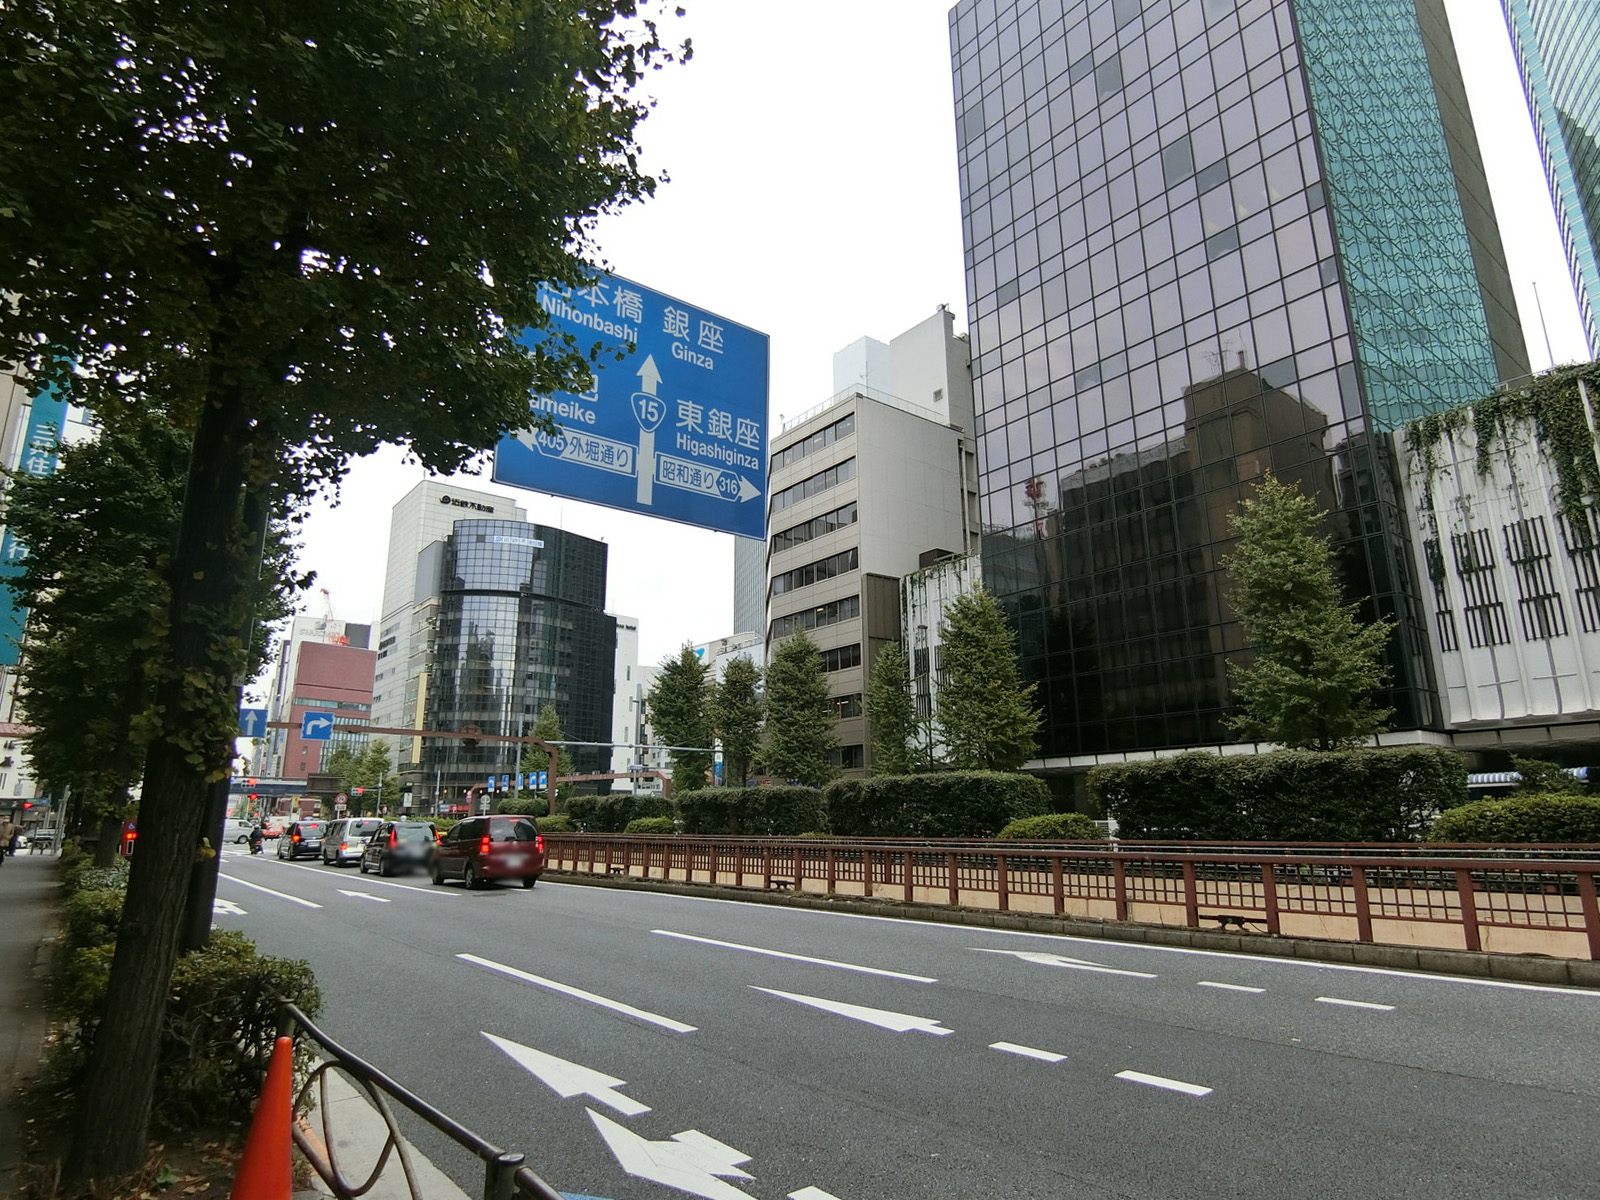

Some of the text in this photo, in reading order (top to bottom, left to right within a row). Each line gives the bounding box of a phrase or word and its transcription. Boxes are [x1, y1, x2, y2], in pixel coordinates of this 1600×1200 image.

[541, 294, 638, 344] Nihonbashi
[662, 304, 724, 355] 銀座
[671, 341, 714, 371] Ginza
[528, 394, 597, 425] ameike
[638, 398, 660, 423] 15
[675, 398, 760, 451] 東銀座
[538, 430, 565, 451] 405
[569, 436, 628, 468] 外堀通り
[676, 432, 759, 471] Higashiginza
[662, 459, 714, 490] 昭和通り
[719, 476, 738, 495] 316
